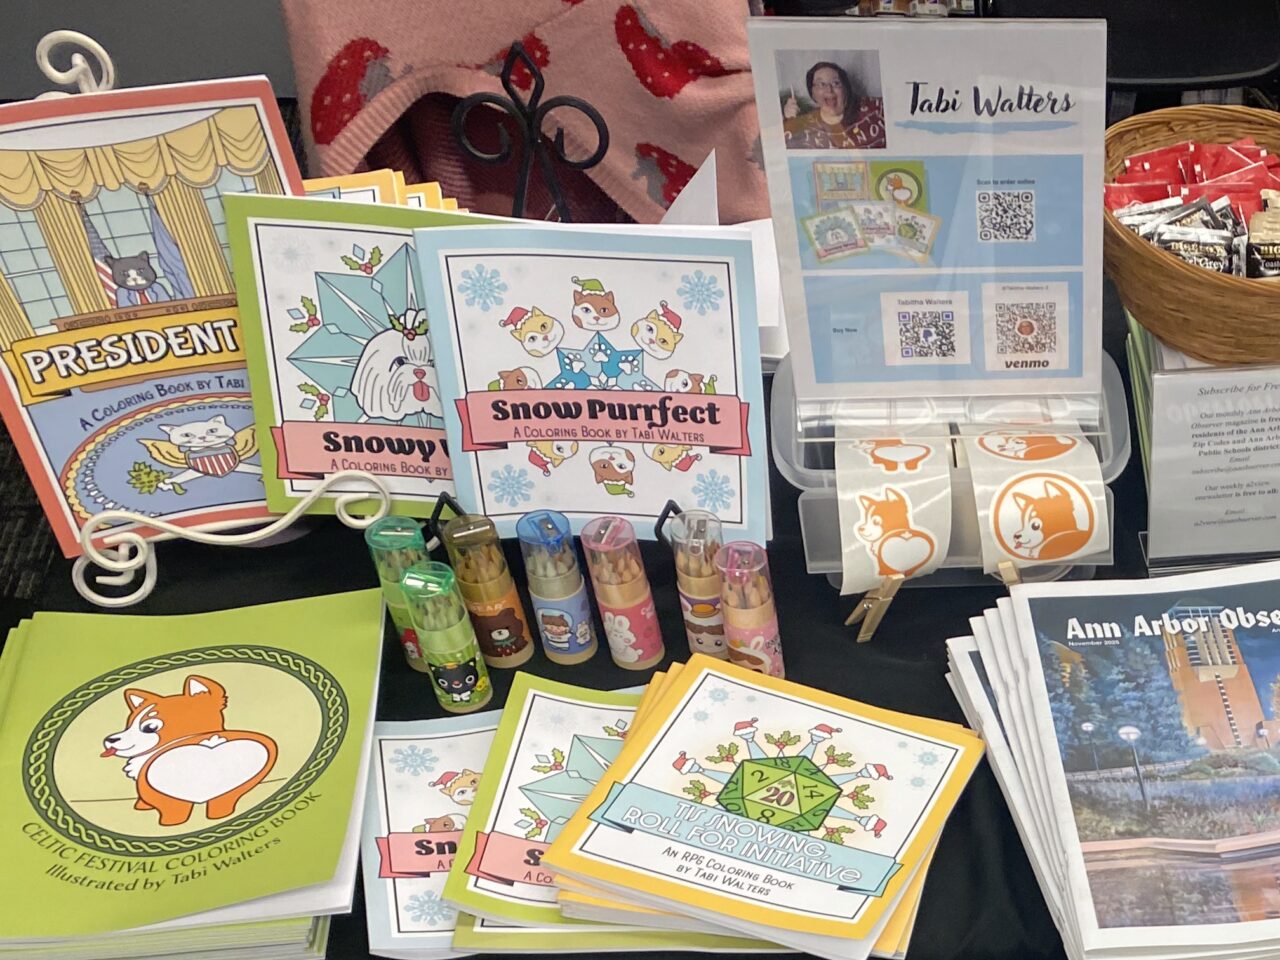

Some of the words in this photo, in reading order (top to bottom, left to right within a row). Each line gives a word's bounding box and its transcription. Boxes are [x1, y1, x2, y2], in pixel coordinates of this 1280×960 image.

[905, 82, 962, 115] Tabi
[972, 85, 1076, 117] Walters
[1200, 257, 1224, 272] Grey
[22, 318, 240, 384] PRESIDENT
[1004, 359, 1050, 369] venmo
[1198, 385, 1245, 396] Subscribe
[1246, 384, 1261, 394] for
[79, 418, 93, 431] A
[92, 390, 154, 420] COLORING
[155, 381, 193, 397] BOOK
[492, 398, 584, 421] Snow
[587, 396, 721, 430] Purrfect
[322, 431, 436, 461] Snowy
[513, 427, 522, 438] A
[524, 427, 578, 438] COLORING
[581, 428, 612, 440] BOOK
[658, 430, 705, 443] WALTERS
[1192, 431, 1225, 439] residents
[1193, 441, 1206, 449] Zip
[1198, 449, 1221, 457] Public
[330, 460, 340, 470] A
[400, 462, 432, 476] BOOK
[1067, 617, 1122, 640] Ann
[1134, 613, 1210, 637] Arbor
[760, 787, 795, 806] 20
[21, 821, 78, 860] CELTIC
[74, 850, 158, 874] FESTIVAL
[165, 824, 269, 871] COLORING
[271, 791, 323, 830] BOOK
[622, 807, 681, 838] ROLL
[687, 826, 738, 853] FOR
[706, 810, 832, 860] SNOWING,
[45, 864, 140, 893] Illustrated
[143, 878, 165, 893] by
[171, 870, 208, 886] Tabi
[213, 836, 282, 872] Walters
[437, 860, 445, 870] A
[524, 871, 532, 881] A
[681, 852, 704, 865] RPG
[706, 858, 761, 882] COLORING
[763, 874, 796, 890] BOOK
[694, 867, 718, 882] TABI
[720, 875, 771, 897] WALTERS
